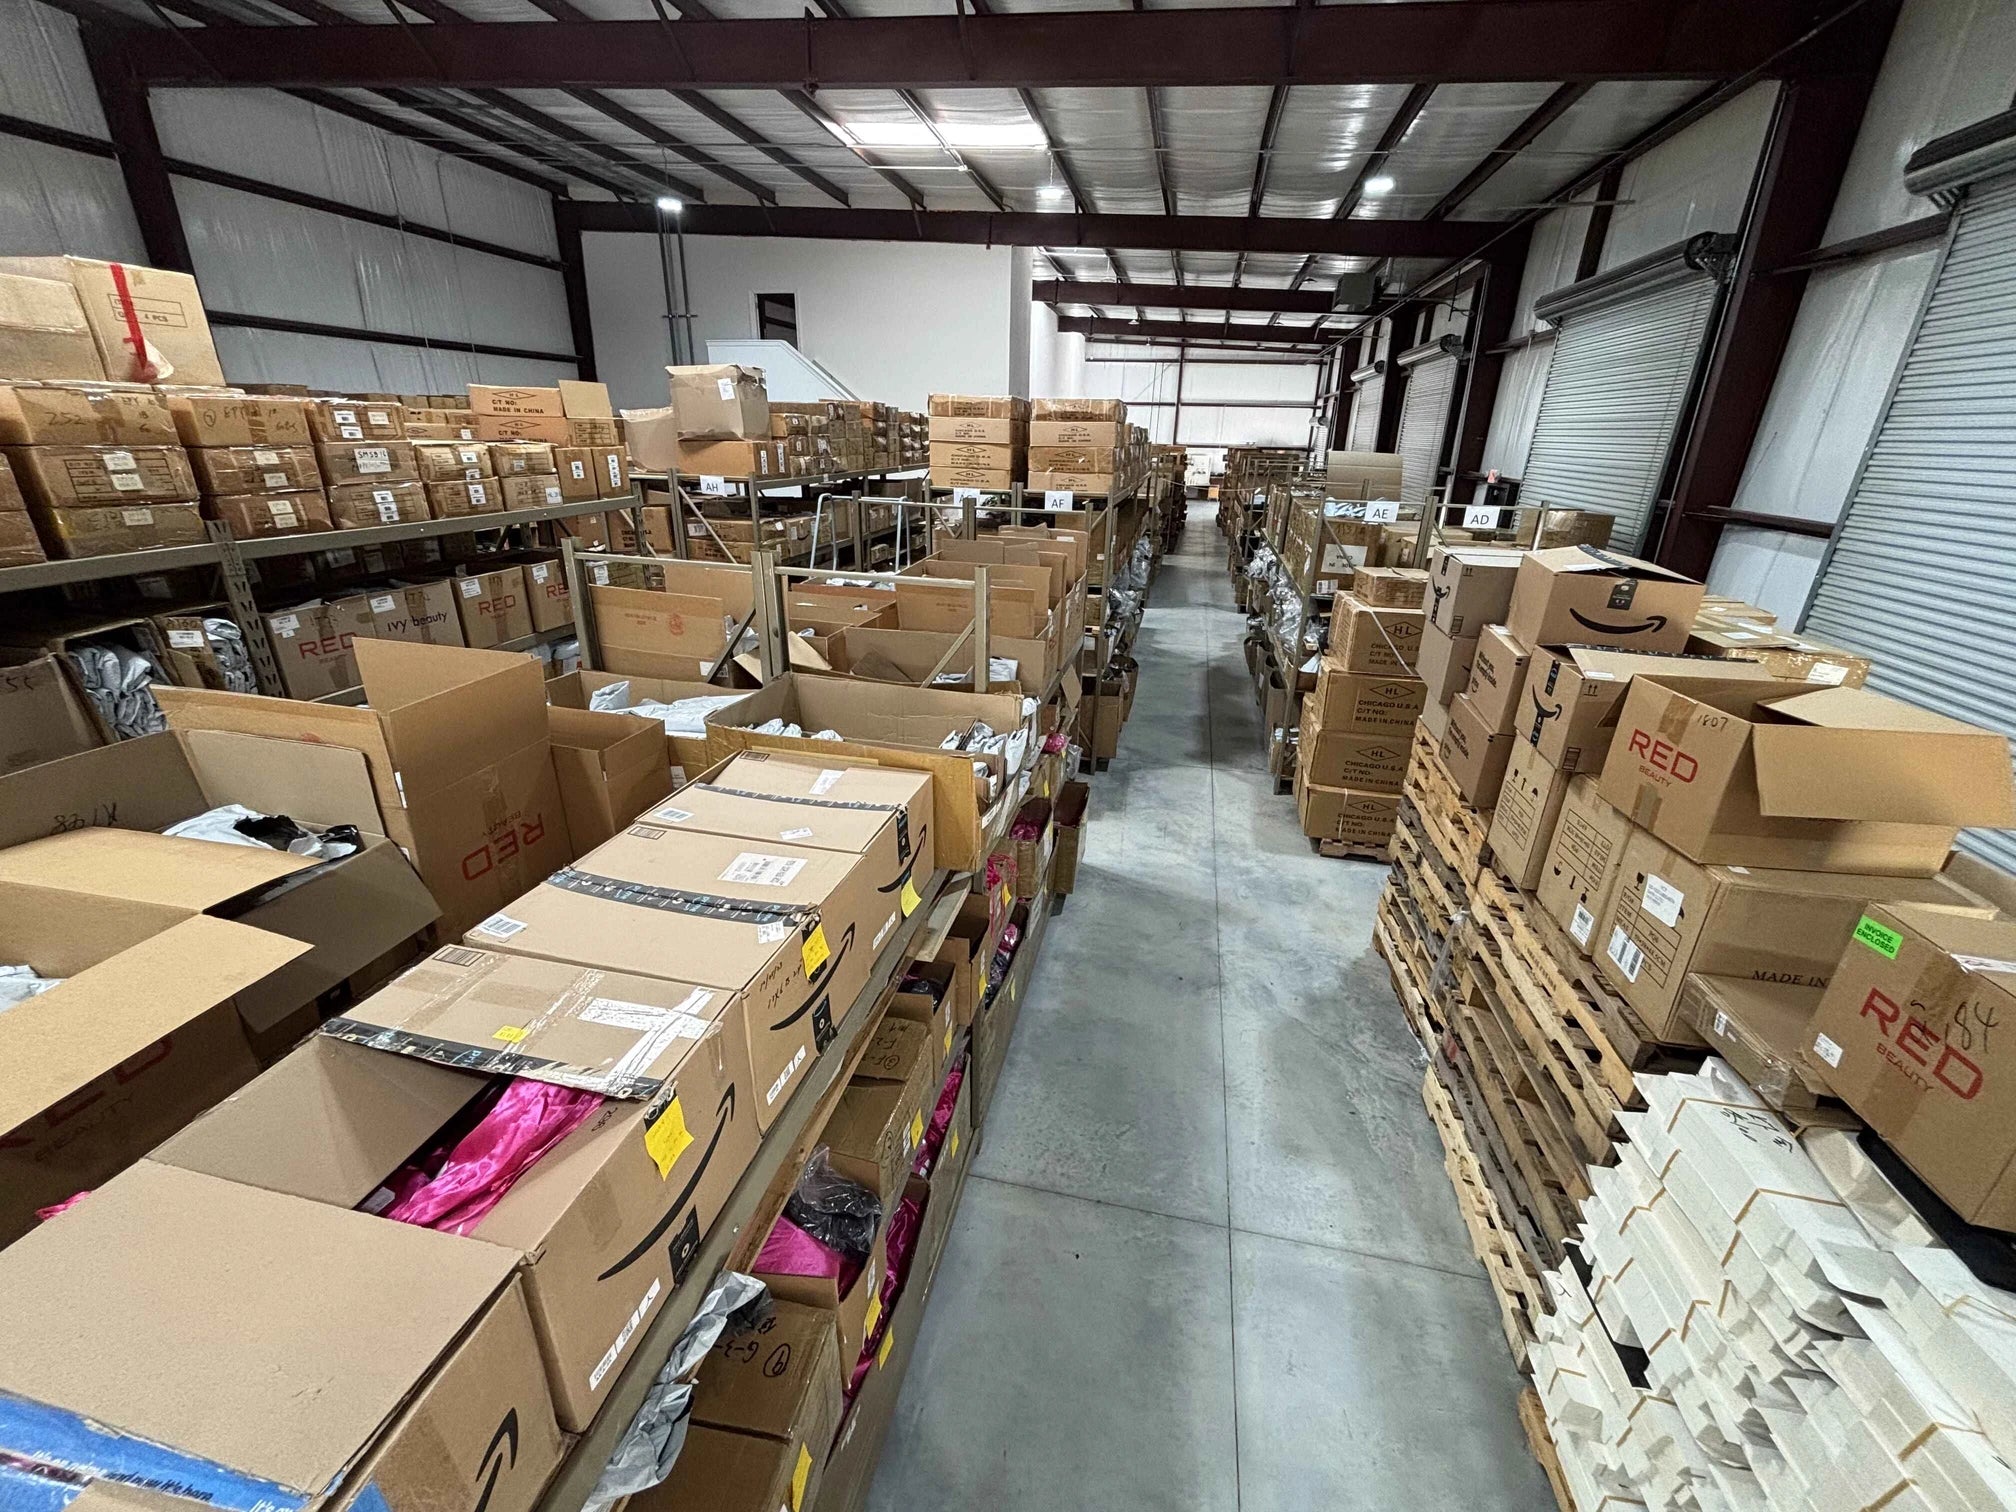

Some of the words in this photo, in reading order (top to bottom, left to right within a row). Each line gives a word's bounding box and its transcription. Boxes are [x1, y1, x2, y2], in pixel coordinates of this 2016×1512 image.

[706, 483, 719, 492] AH
[1051, 498, 1065, 508] AF
[1372, 508, 1389, 519] AE
[1470, 514, 1490, 525] AD
[546, 583, 570, 599] RE
[477, 594, 516, 616] RED
[411, 612, 448, 627] beauty
[300, 631, 357, 660] RED
[1368, 658, 1386, 666] MADE
[1357, 707, 1371, 715] C/T
[1358, 699, 1396, 709] CHICAGO
[1389, 718, 1415, 726] CHINA
[1697, 714, 1729, 732] 1807
[1628, 728, 1699, 784] RED
[1344, 760, 1381, 770] CHICAGO
[1341, 775, 1364, 784] MADE
[1639, 764, 1672, 788] BEAUTY
[482, 810, 521, 837] BEAUTY
[1337, 812, 1373, 821] CHICAGO
[461, 812, 545, 881] RED
[1864, 922, 1894, 944] INVOICE
[1856, 928, 1896, 955] ENCLOSED
[1752, 970, 1801, 986] MADE
[1807, 975, 1829, 988] IN
[1859, 986, 1985, 1101] RED
[1876, 1042, 1935, 1093] BEAUTY
